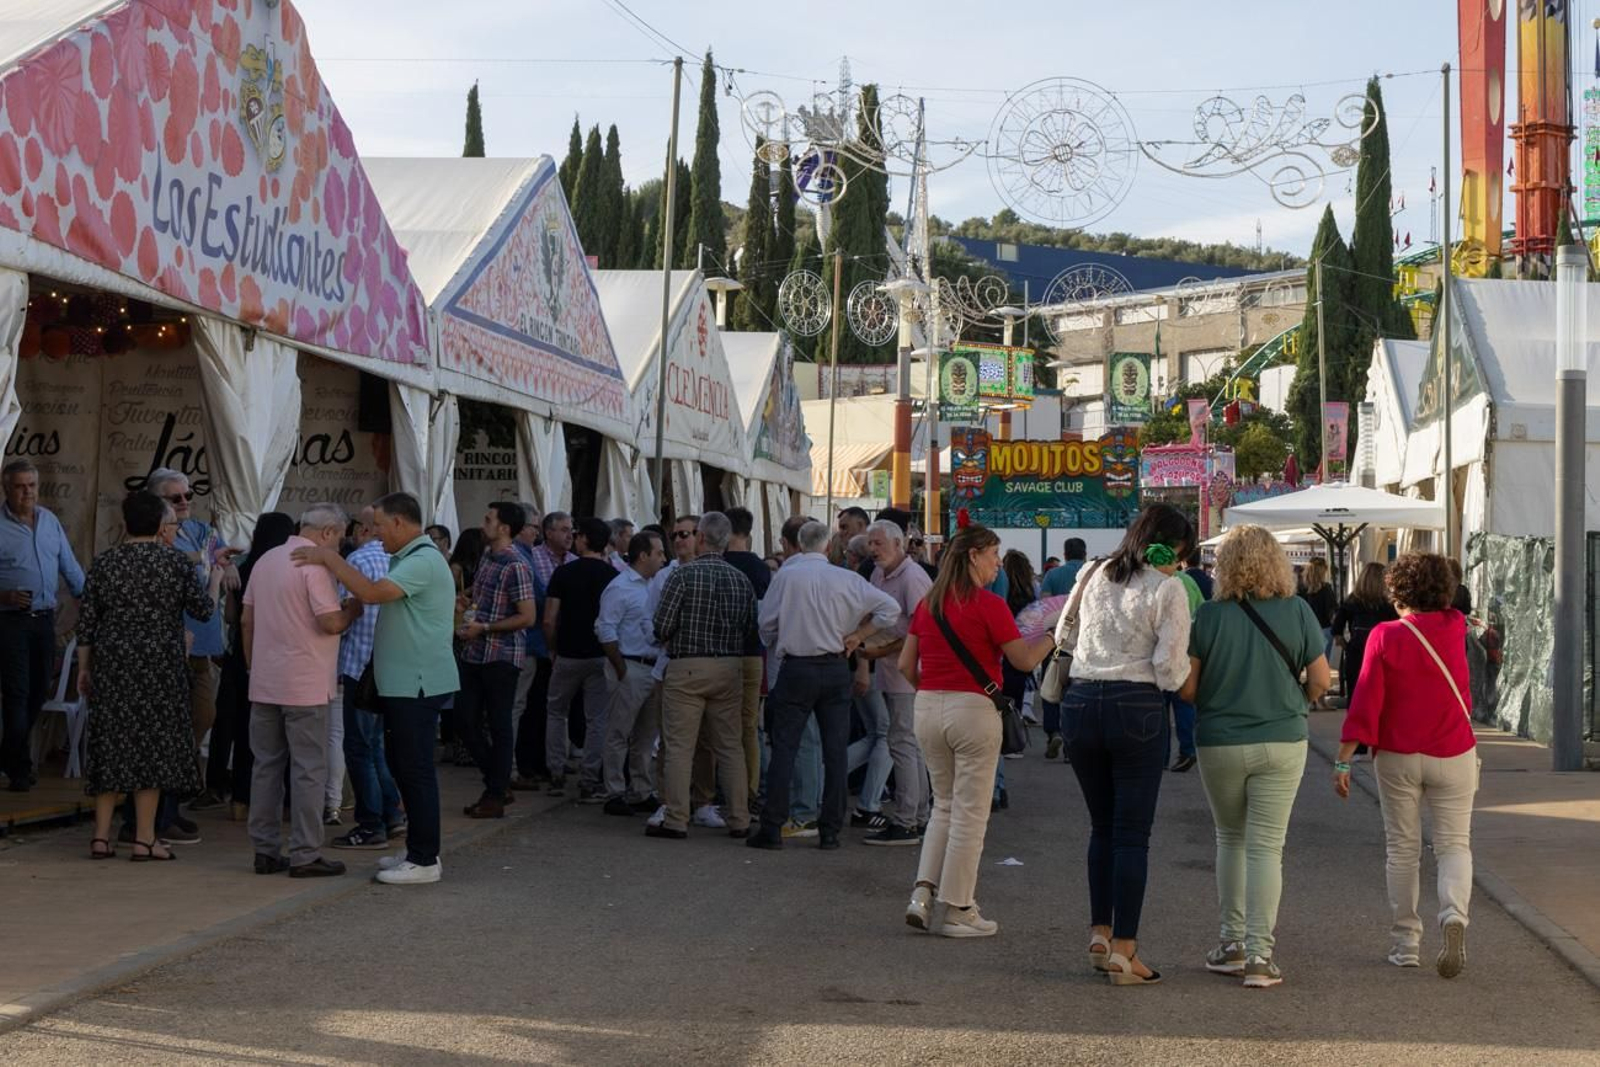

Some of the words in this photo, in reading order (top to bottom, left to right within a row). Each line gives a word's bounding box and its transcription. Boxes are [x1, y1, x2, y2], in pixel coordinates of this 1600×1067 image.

[200, 172, 347, 304] Estudiantes
[989, 442, 1101, 477] MOJITOS
[1005, 481, 1052, 493] SAVAGE
[1054, 481, 1084, 493] CLUB
